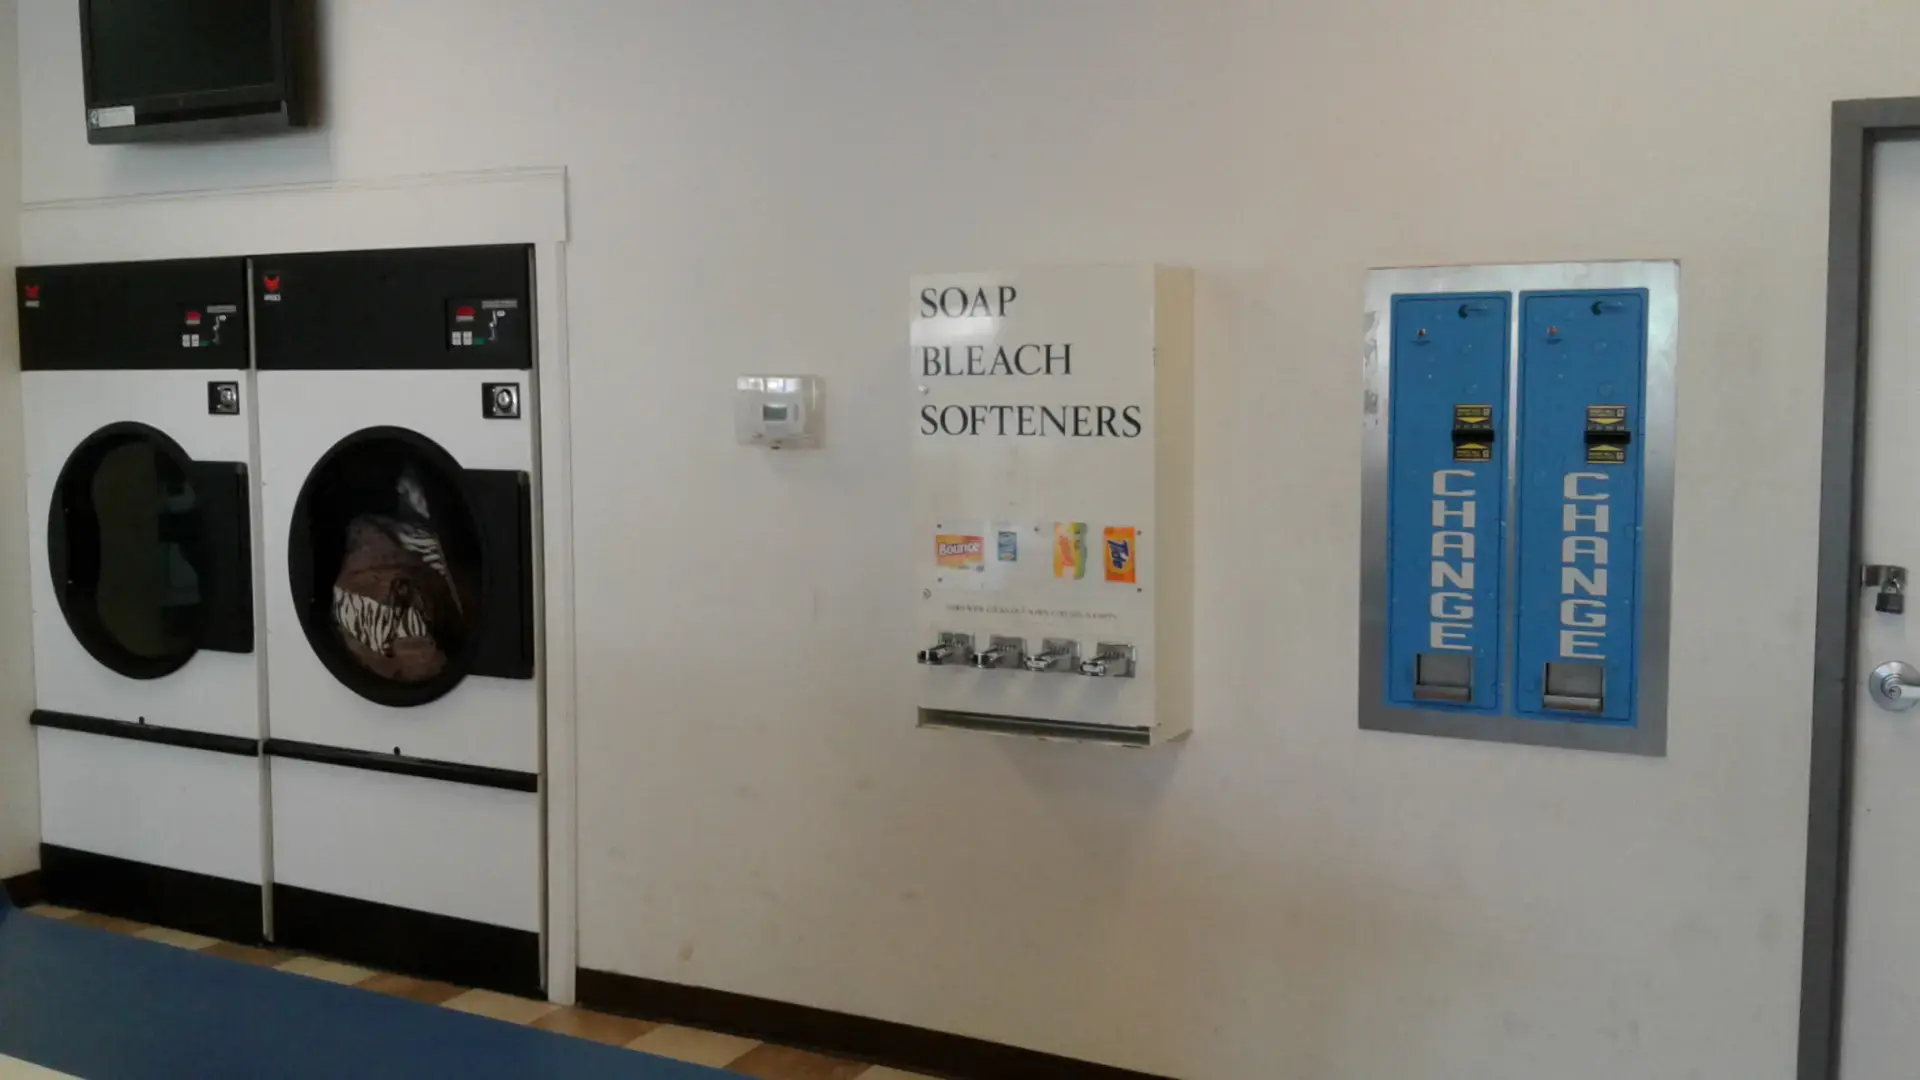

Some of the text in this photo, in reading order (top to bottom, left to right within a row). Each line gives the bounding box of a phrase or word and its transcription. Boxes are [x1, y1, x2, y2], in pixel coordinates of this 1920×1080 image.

[920, 285, 1017, 318] SOAP
[922, 343, 1072, 377] BLEACH
[920, 404, 1142, 438] SOFTENERS
[938, 541, 980, 556] Bounce
[1429, 469, 1477, 651] CHANGE
[1559, 471, 1611, 660] CHANGE
